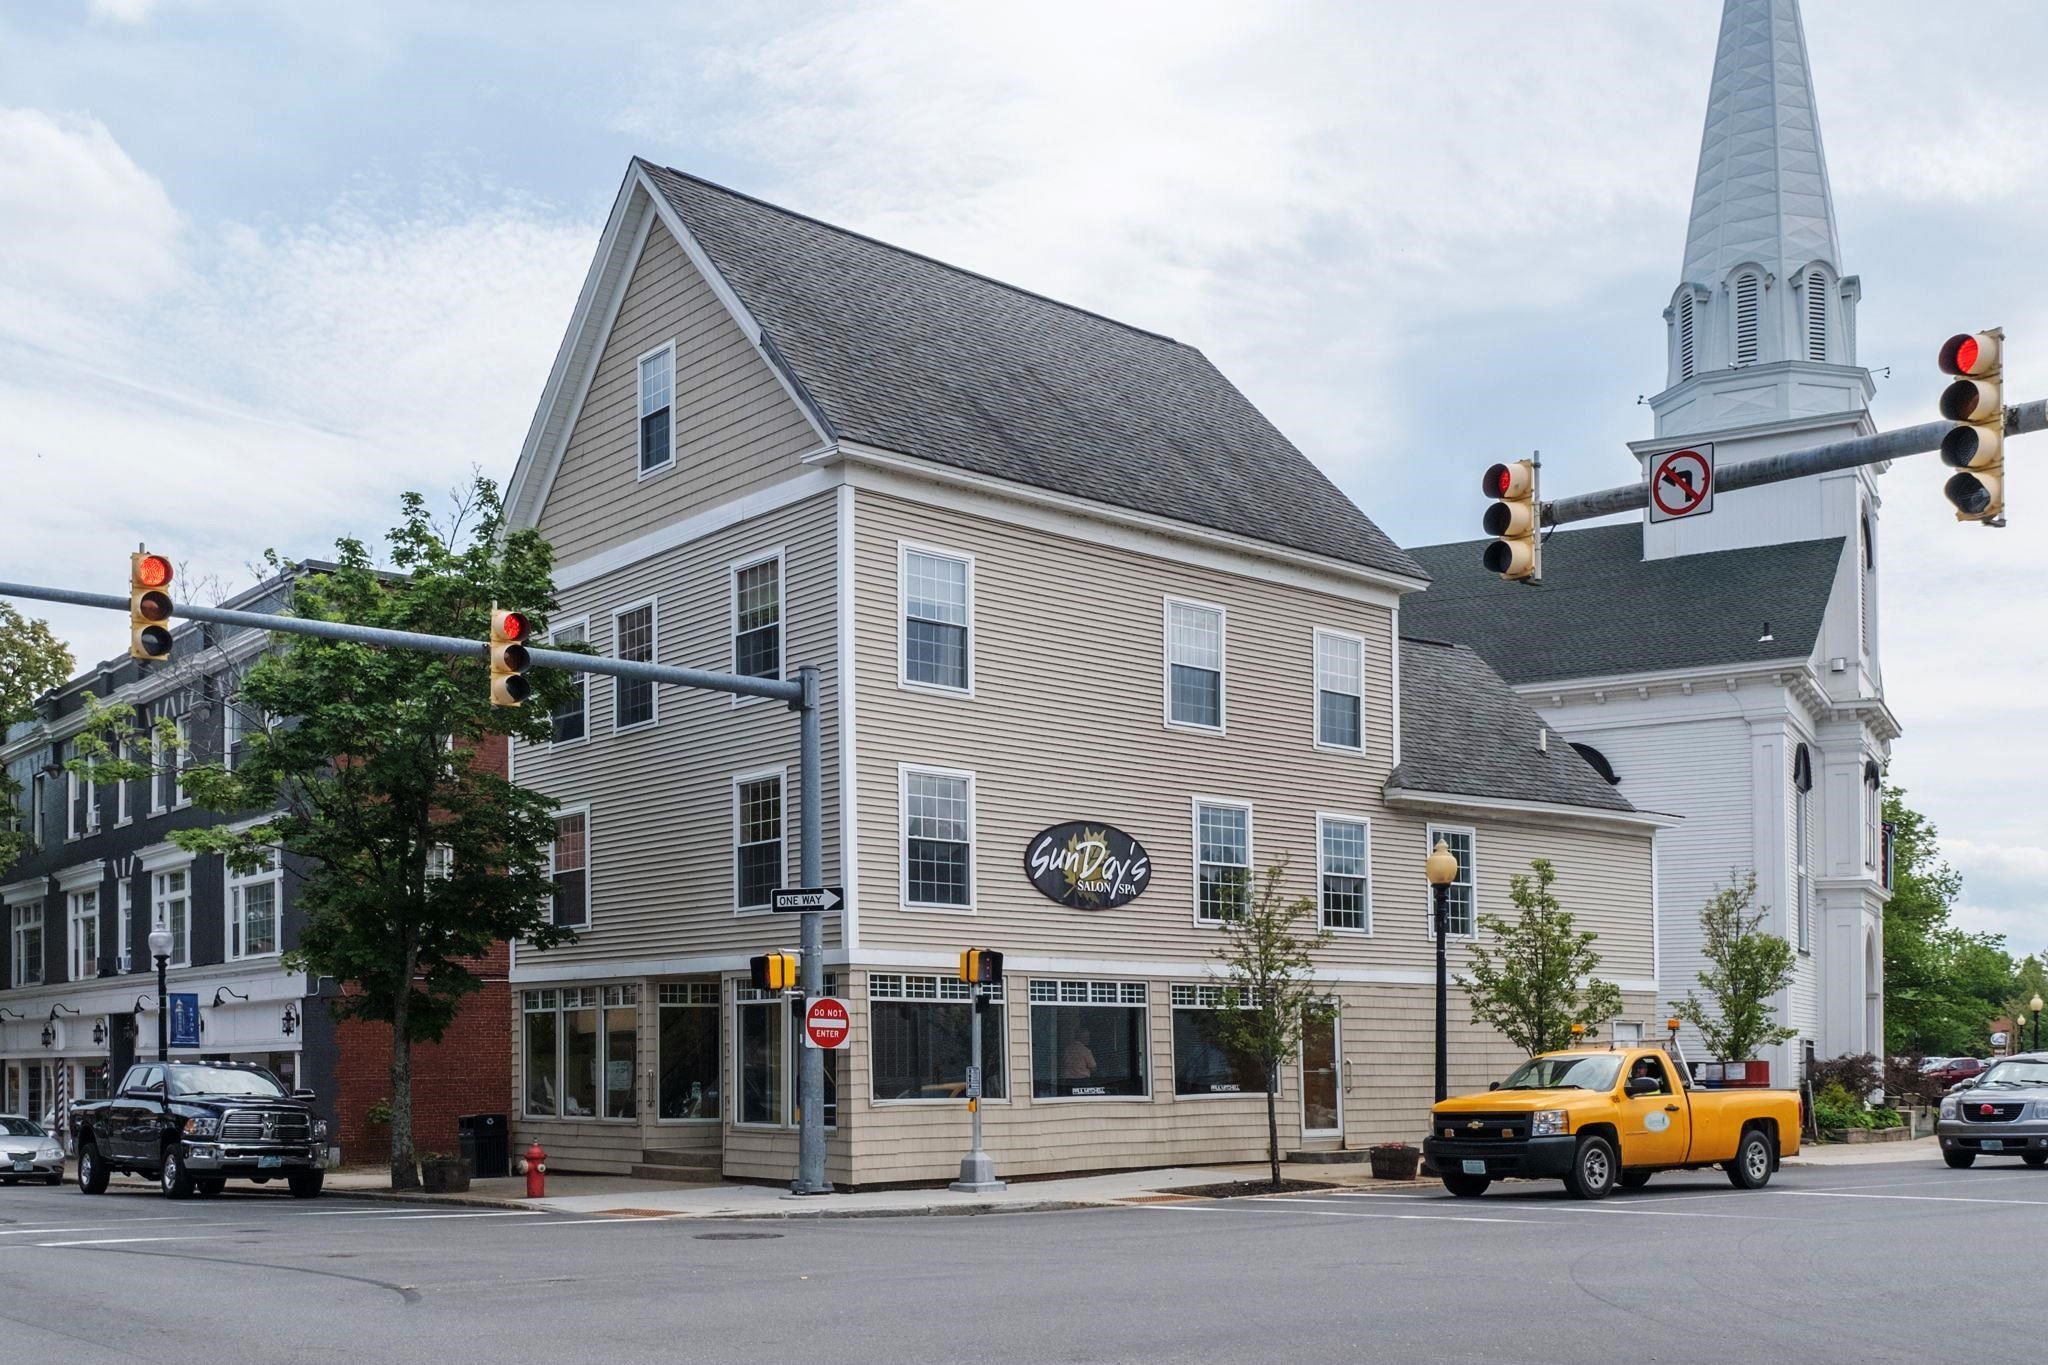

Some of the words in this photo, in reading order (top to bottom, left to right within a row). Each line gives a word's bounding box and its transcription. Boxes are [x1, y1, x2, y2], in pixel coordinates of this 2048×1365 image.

[1031, 836, 1148, 900] SunDay's
[1077, 880, 1111, 893] SALON
[1118, 883, 1137, 895] SPA
[779, 895, 798, 906] ONE
[802, 894, 822, 905] WAY
[814, 1008, 825, 1017] DO
[827, 1009, 843, 1017] NOT
[816, 1029, 839, 1038] ENTER
